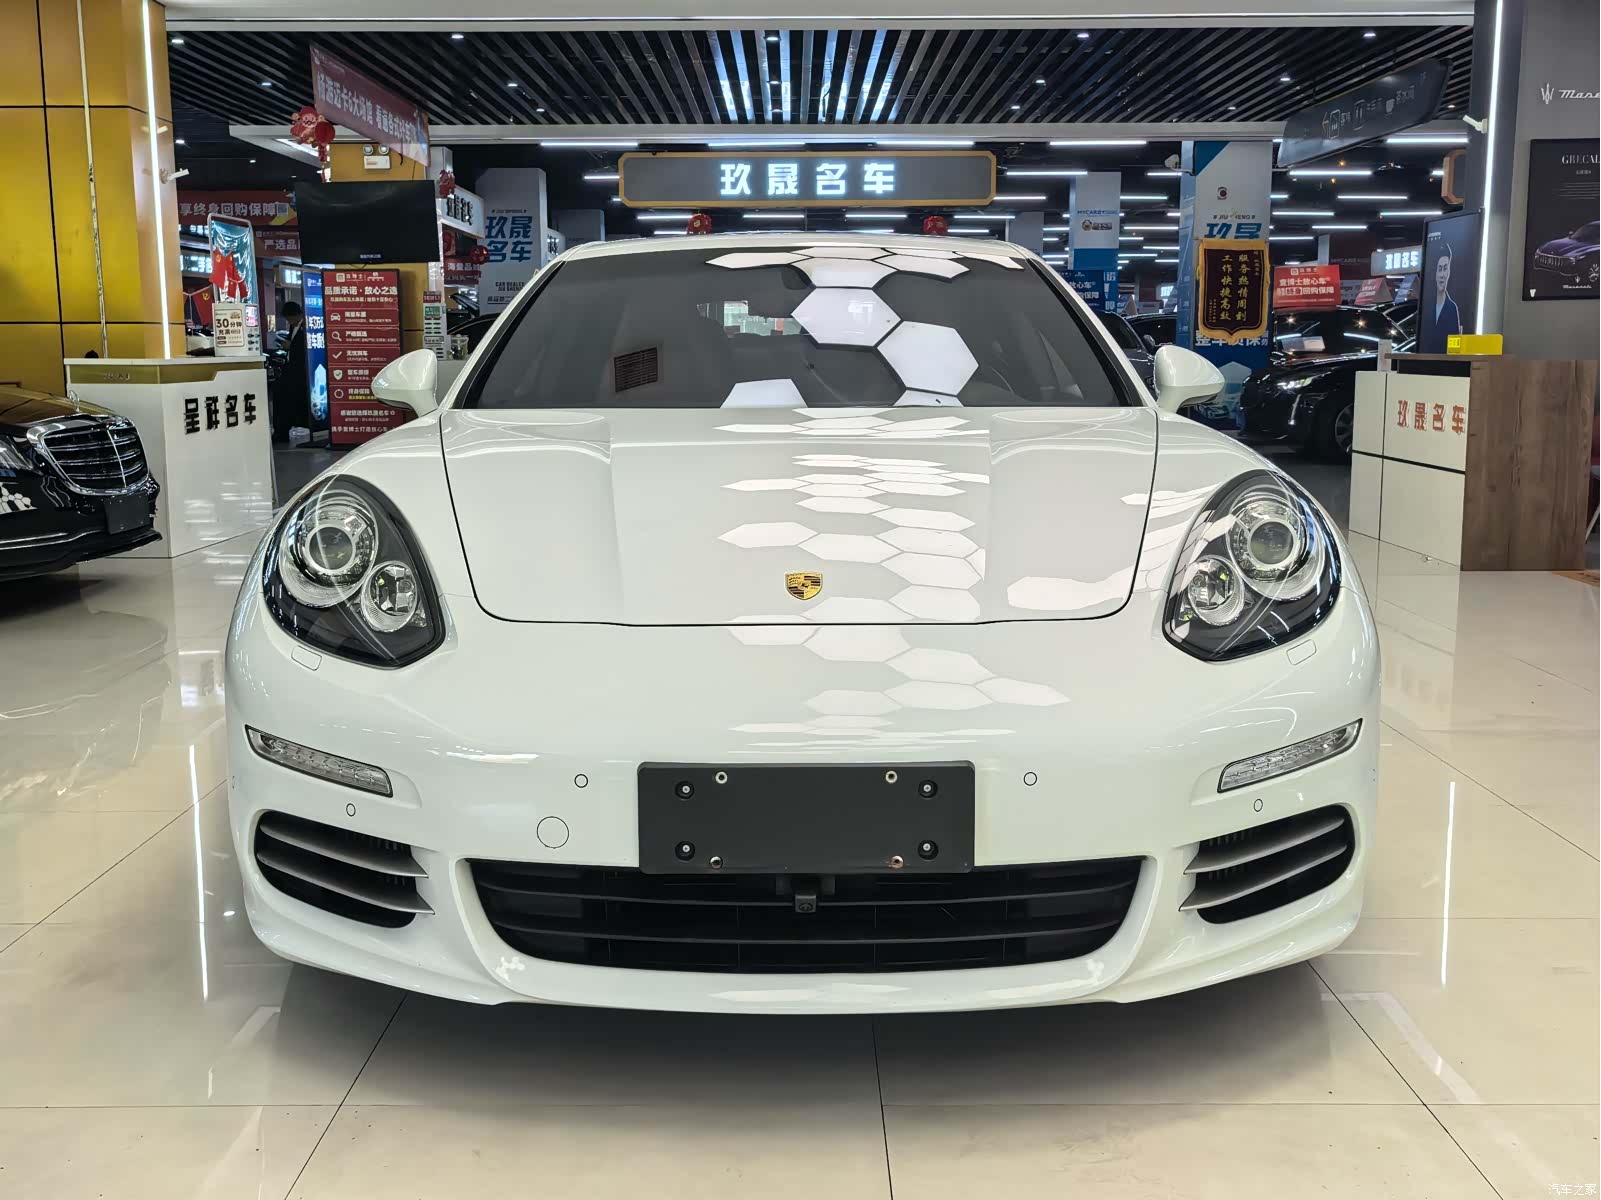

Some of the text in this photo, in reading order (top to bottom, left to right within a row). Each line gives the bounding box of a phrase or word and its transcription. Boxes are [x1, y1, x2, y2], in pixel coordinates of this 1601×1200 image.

[720, 163, 895, 195] 玖晟名车
[485, 216, 533, 239] 玖晟
[264, 239, 300, 251] 严选品
[487, 240, 533, 262] 名车
[1219, 254, 1233, 321] 工作快捷高效
[1235, 254, 1250, 322] 服务热情周到
[215, 318, 242, 329] 30分钟
[184, 393, 256, 435] 呈祥名车
[1397, 400, 1466, 435] 玖晟名车
